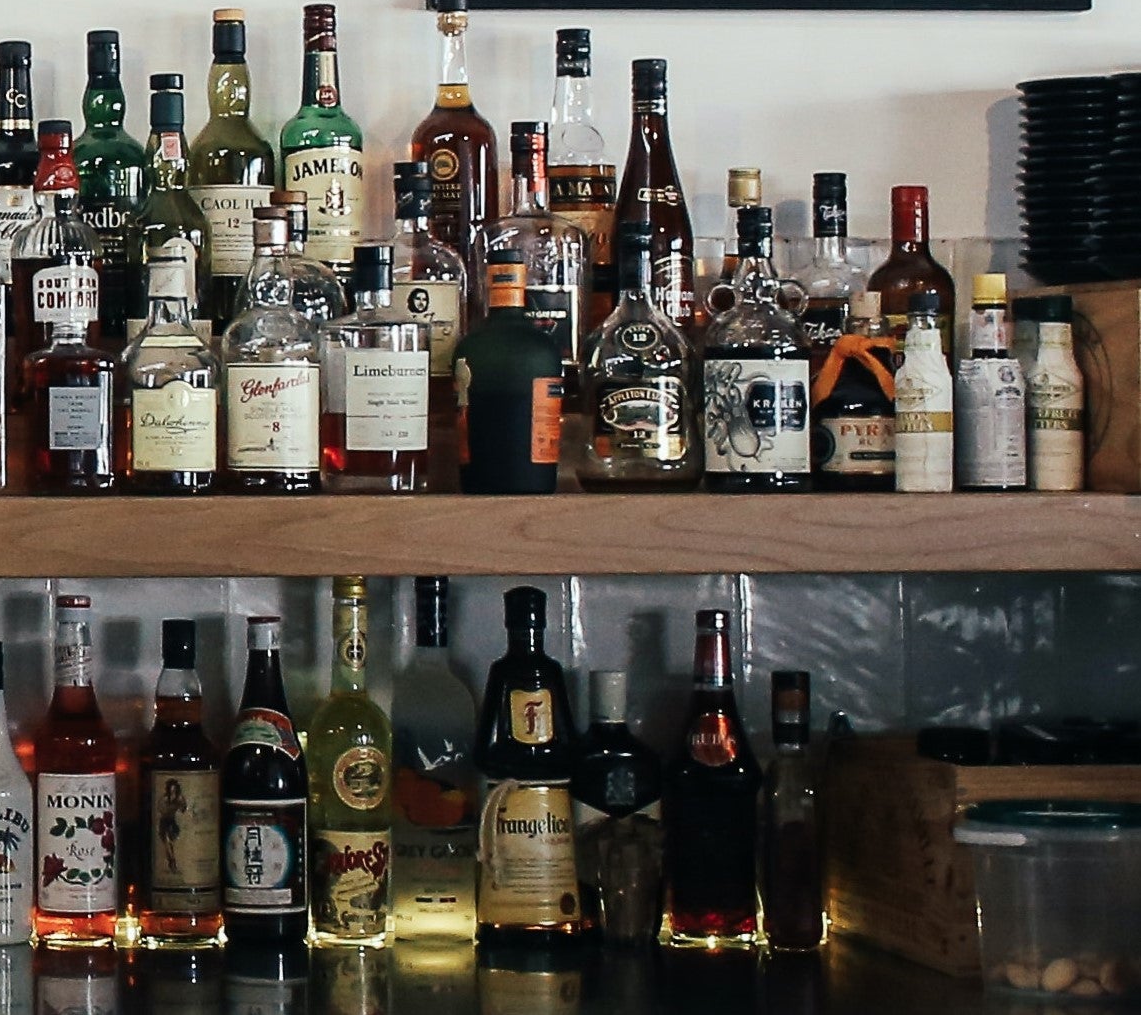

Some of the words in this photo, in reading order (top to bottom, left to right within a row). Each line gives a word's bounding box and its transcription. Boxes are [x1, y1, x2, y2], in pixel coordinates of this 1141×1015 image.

[200, 197, 241, 211] CAOL
[226, 217, 241, 229] 12
[271, 421, 280, 433] 8
[46, 794, 114, 809] MONIN
